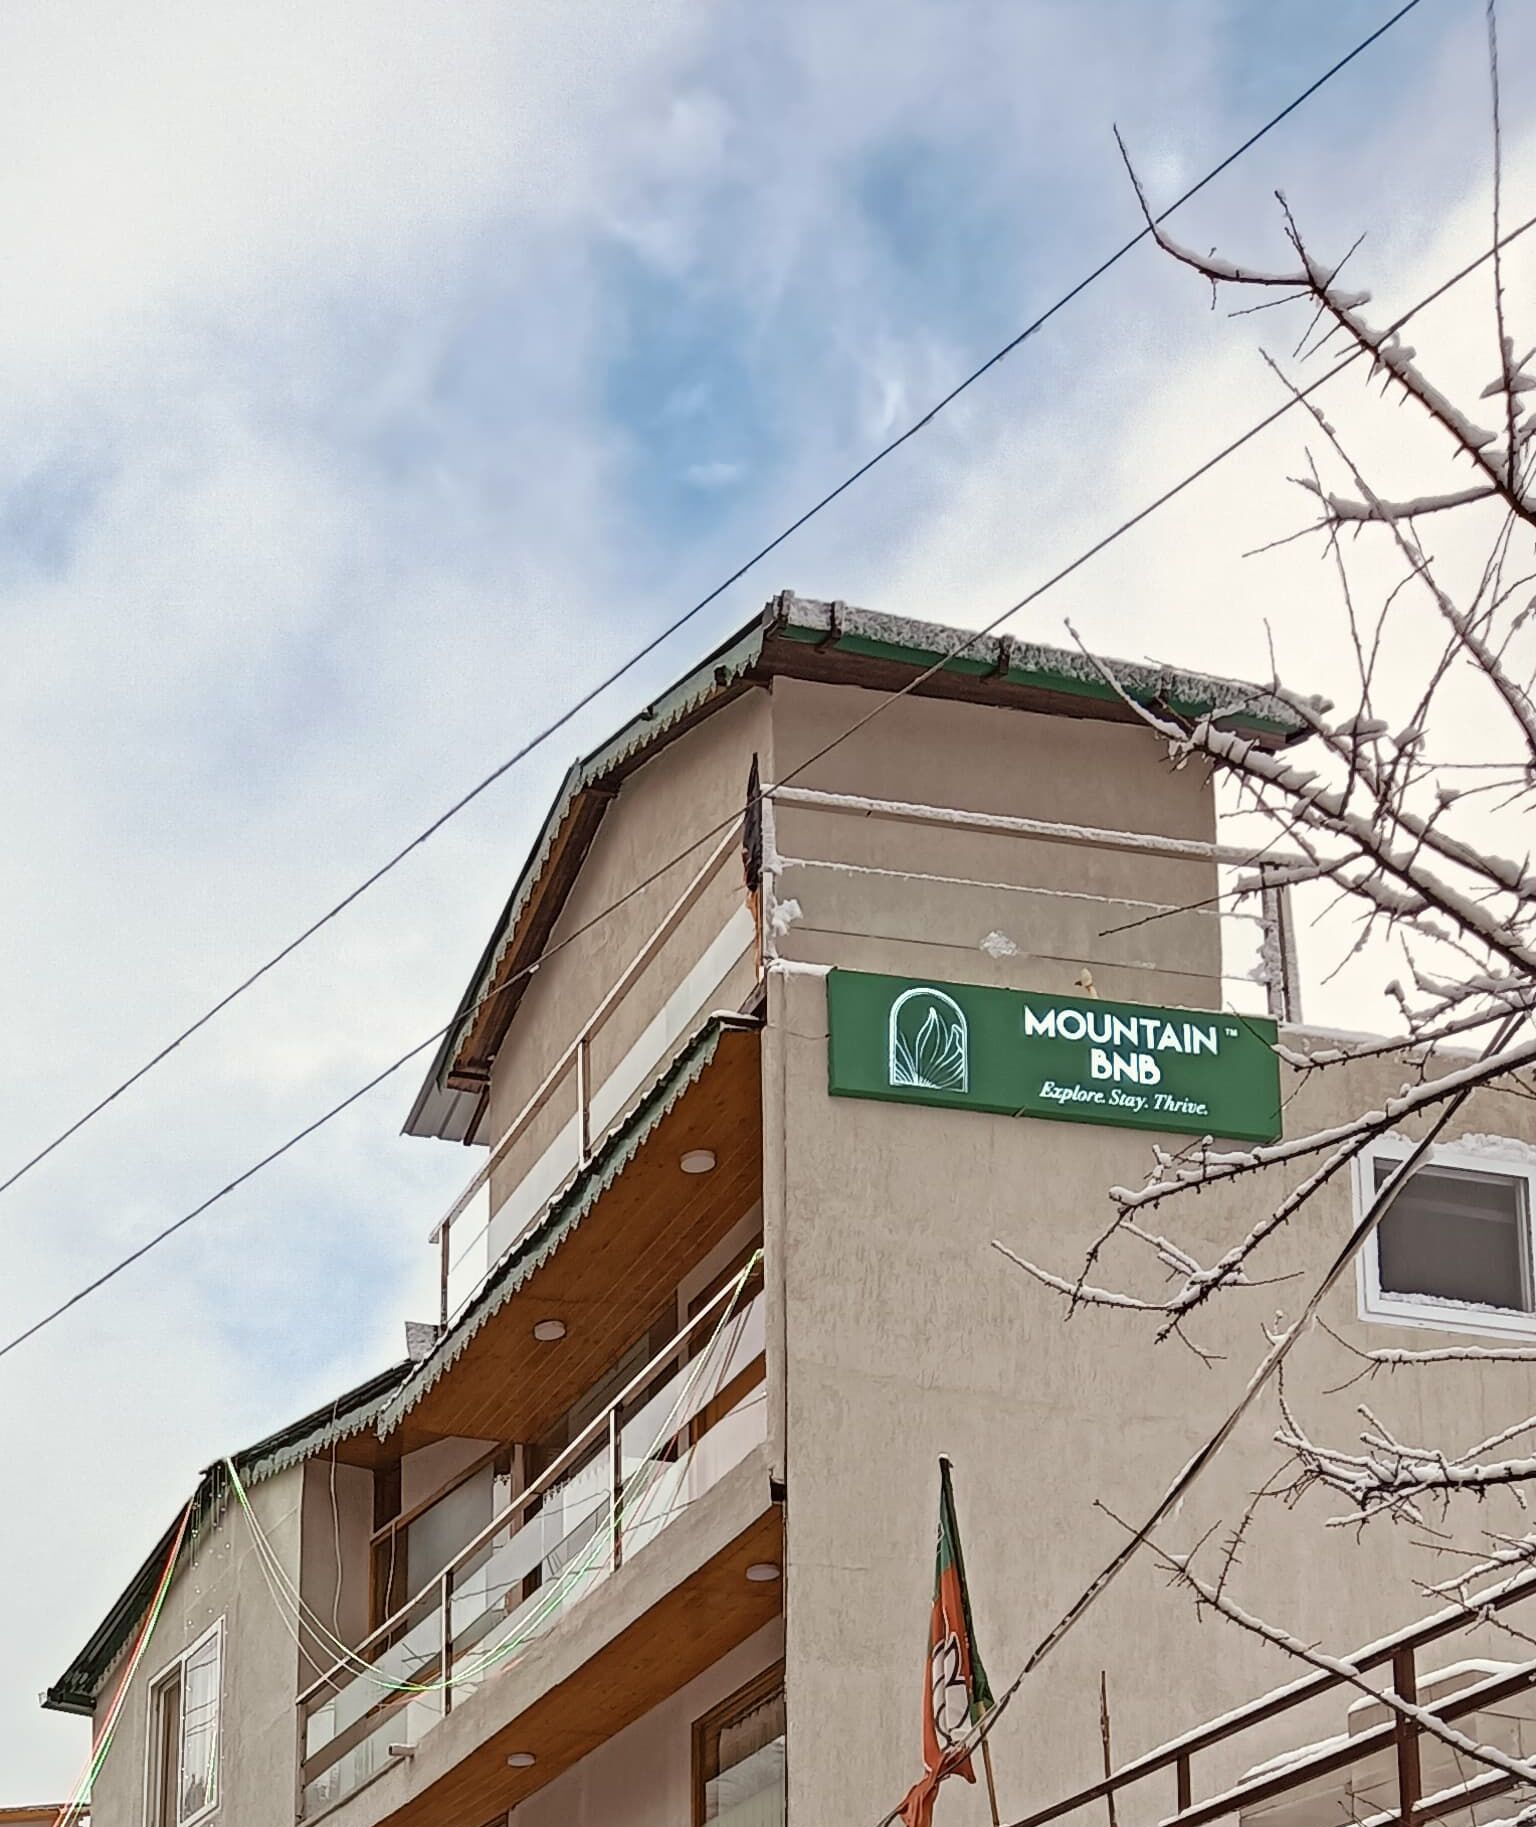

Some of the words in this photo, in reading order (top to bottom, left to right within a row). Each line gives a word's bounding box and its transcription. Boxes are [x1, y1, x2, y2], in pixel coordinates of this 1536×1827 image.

[1023, 1004, 1219, 1056] MOUNTAIN
[1090, 1049, 1161, 1086] BNB
[1039, 1080, 1106, 1106] Explore.
[1109, 1087, 1149, 1112] Stay.
[1152, 1092, 1210, 1116] Thrive.
